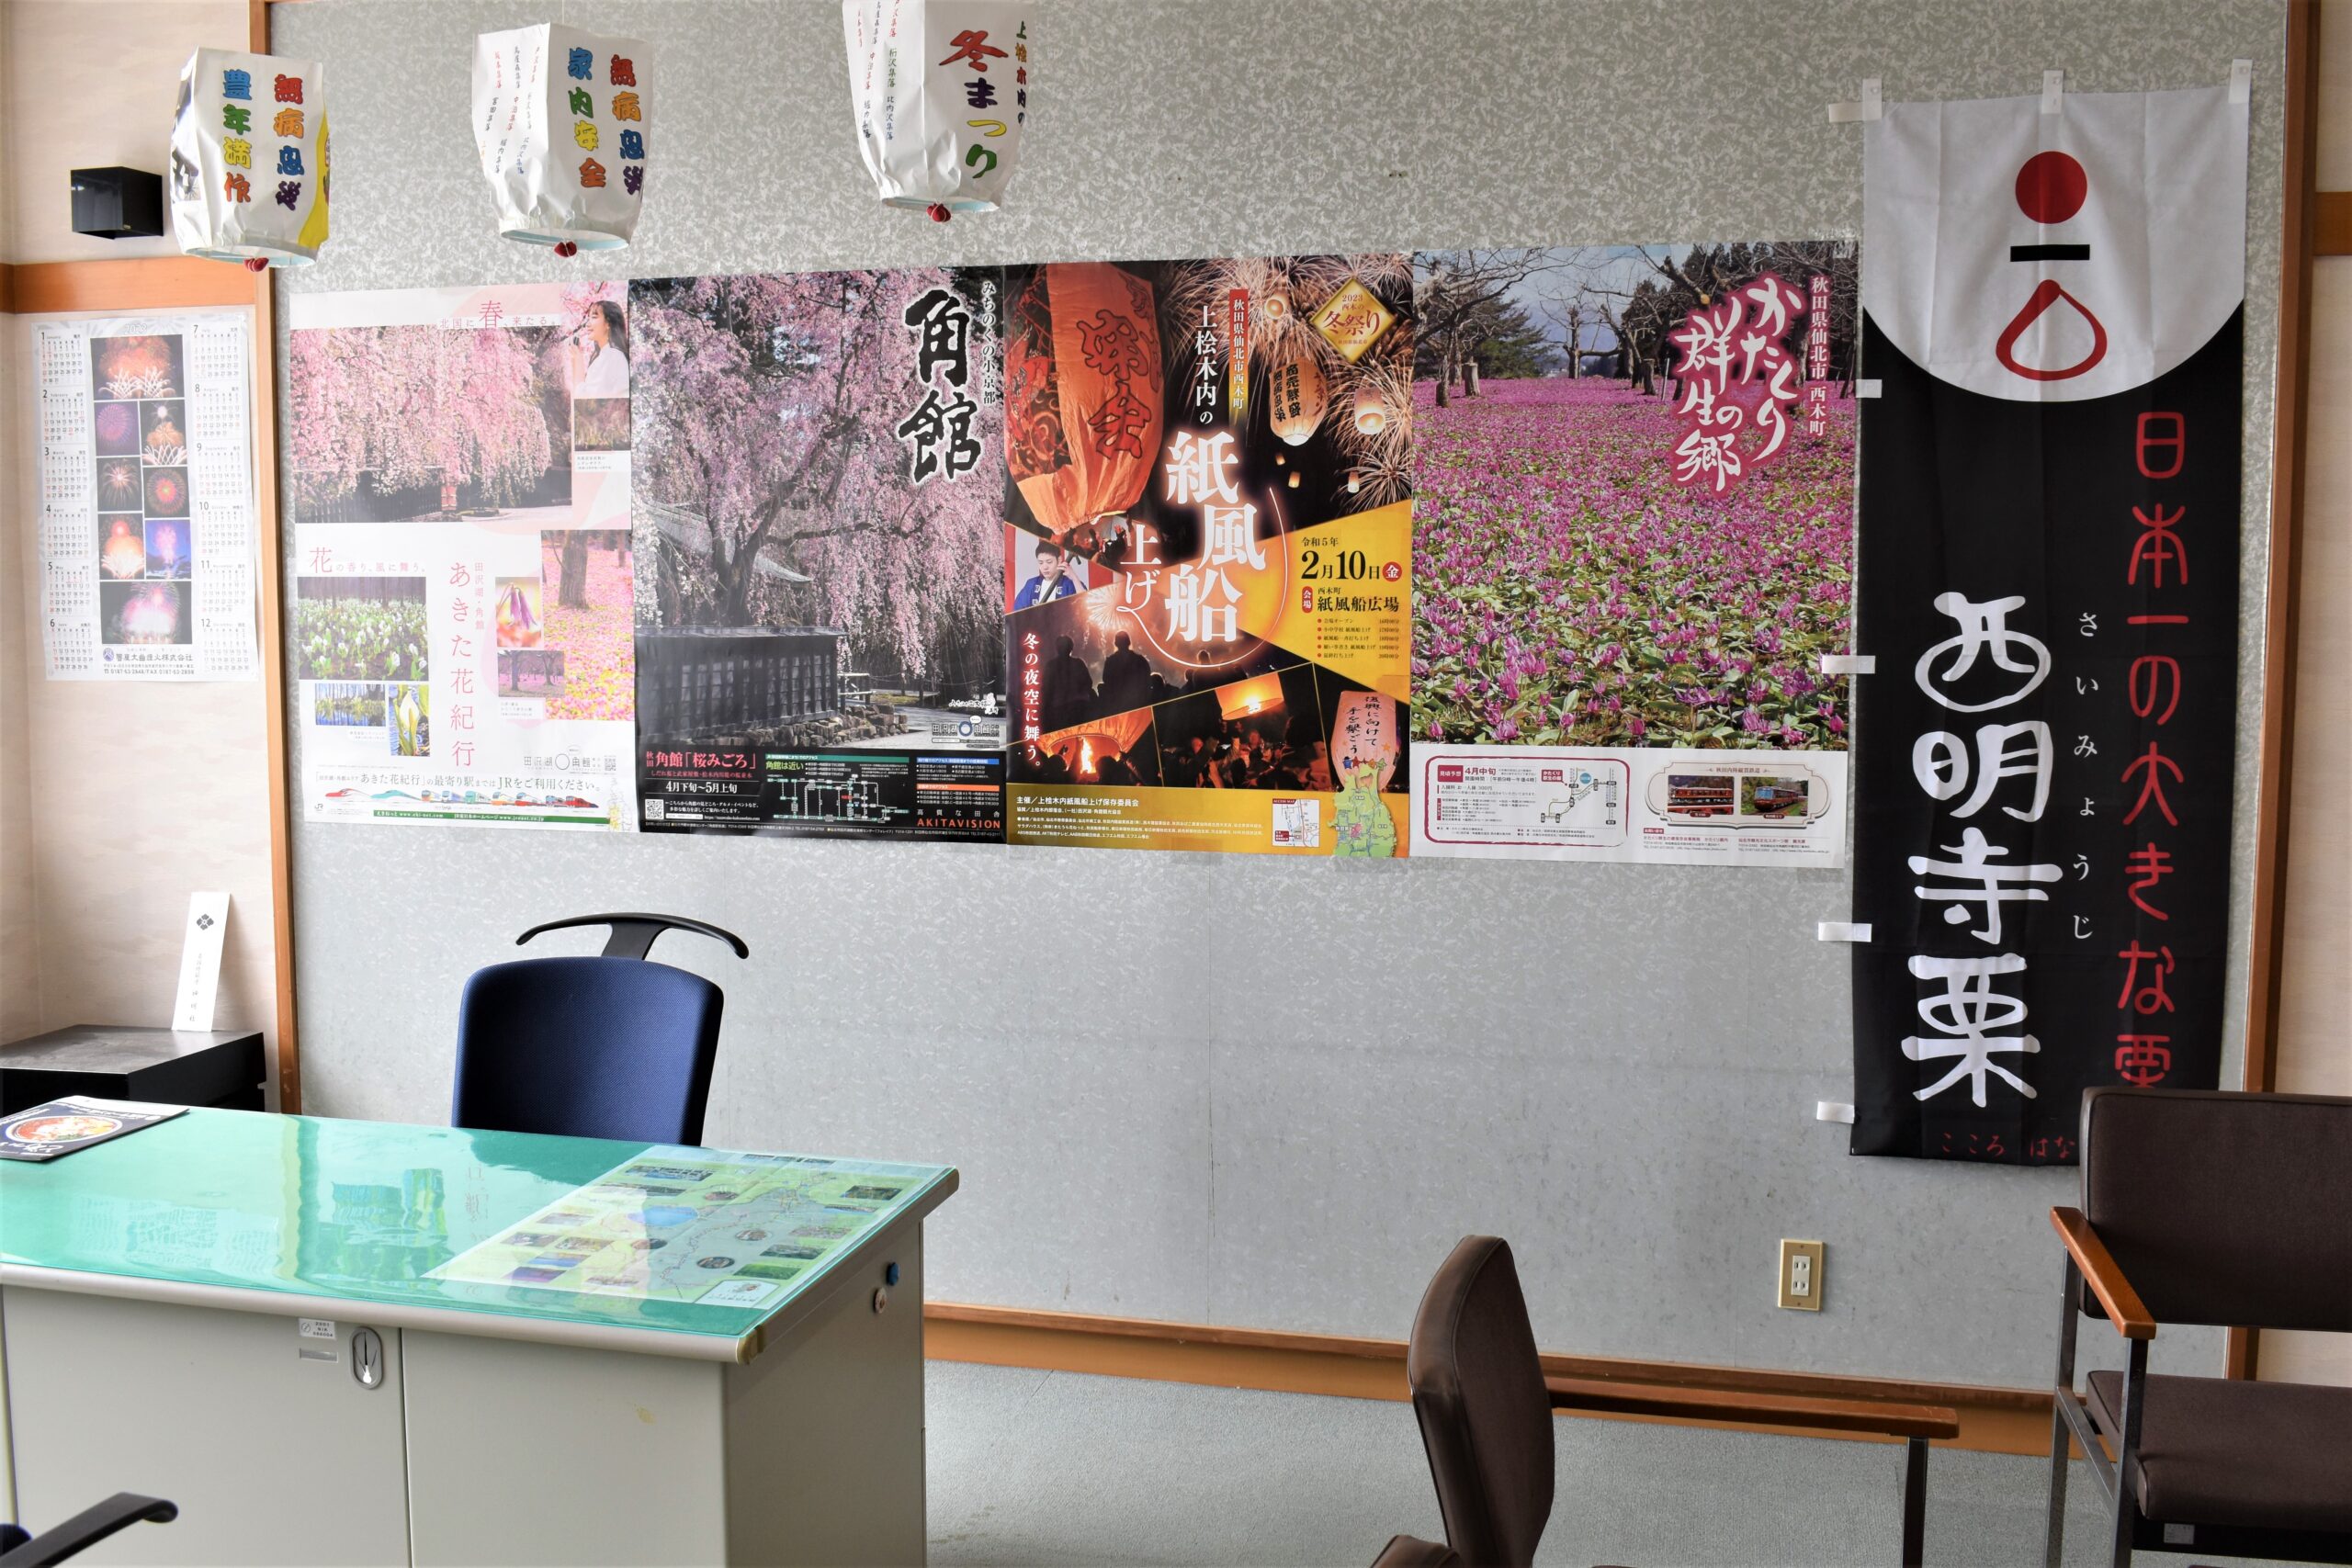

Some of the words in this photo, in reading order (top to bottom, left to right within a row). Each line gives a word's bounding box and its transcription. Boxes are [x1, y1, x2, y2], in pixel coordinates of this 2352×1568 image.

[568, 47, 606, 188] 家内安全
[610, 54, 645, 195] 無病息災
[939, 30, 1009, 178] 冬まつり
[273, 74, 305, 211] 無病息災
[982, 280, 996, 404] みちのくの小京都
[1233, 299, 1245, 410] 秋田県仙北市西木町
[1323, 310, 1380, 336] 冬祭り
[1810, 276, 1829, 379] 秋田県仙北市
[42, 389, 48, 398] 2
[898, 288, 981, 483] 角館
[1195, 306, 1218, 424] 上桧木内の
[1675, 296, 1743, 491] 群生の郷
[1740, 277, 1802, 463] かたくり
[1809, 387, 1827, 436] 西木町
[44, 446, 50, 456] 3
[199, 502, 209, 511] 10
[1165, 431, 1266, 642] 紙風船
[1302, 536, 1339, 547] 令和5年
[48, 561, 52, 570] 5
[1301, 550, 1380, 580] 2月10日
[1385, 564, 1399, 579] 金
[1303, 589, 1312, 609] 会場
[1317, 587, 1341, 595] 西木町
[50, 618, 55, 627] 6
[200, 618, 211, 627] 12
[1317, 596, 1399, 613] 紙風船広場
[449, 561, 476, 767] あきた花紀行
[1023, 632, 1041, 767] 冬の夜空に舞う。
[765, 761, 805, 771] 角館は近い
[1464, 767, 1497, 776] 4月中旬
[2073, 611, 2099, 941] さいみょうじ
[917, 818, 1001, 829] AKITAVISION
[1900, 592, 2063, 1108] 西明寺栗
